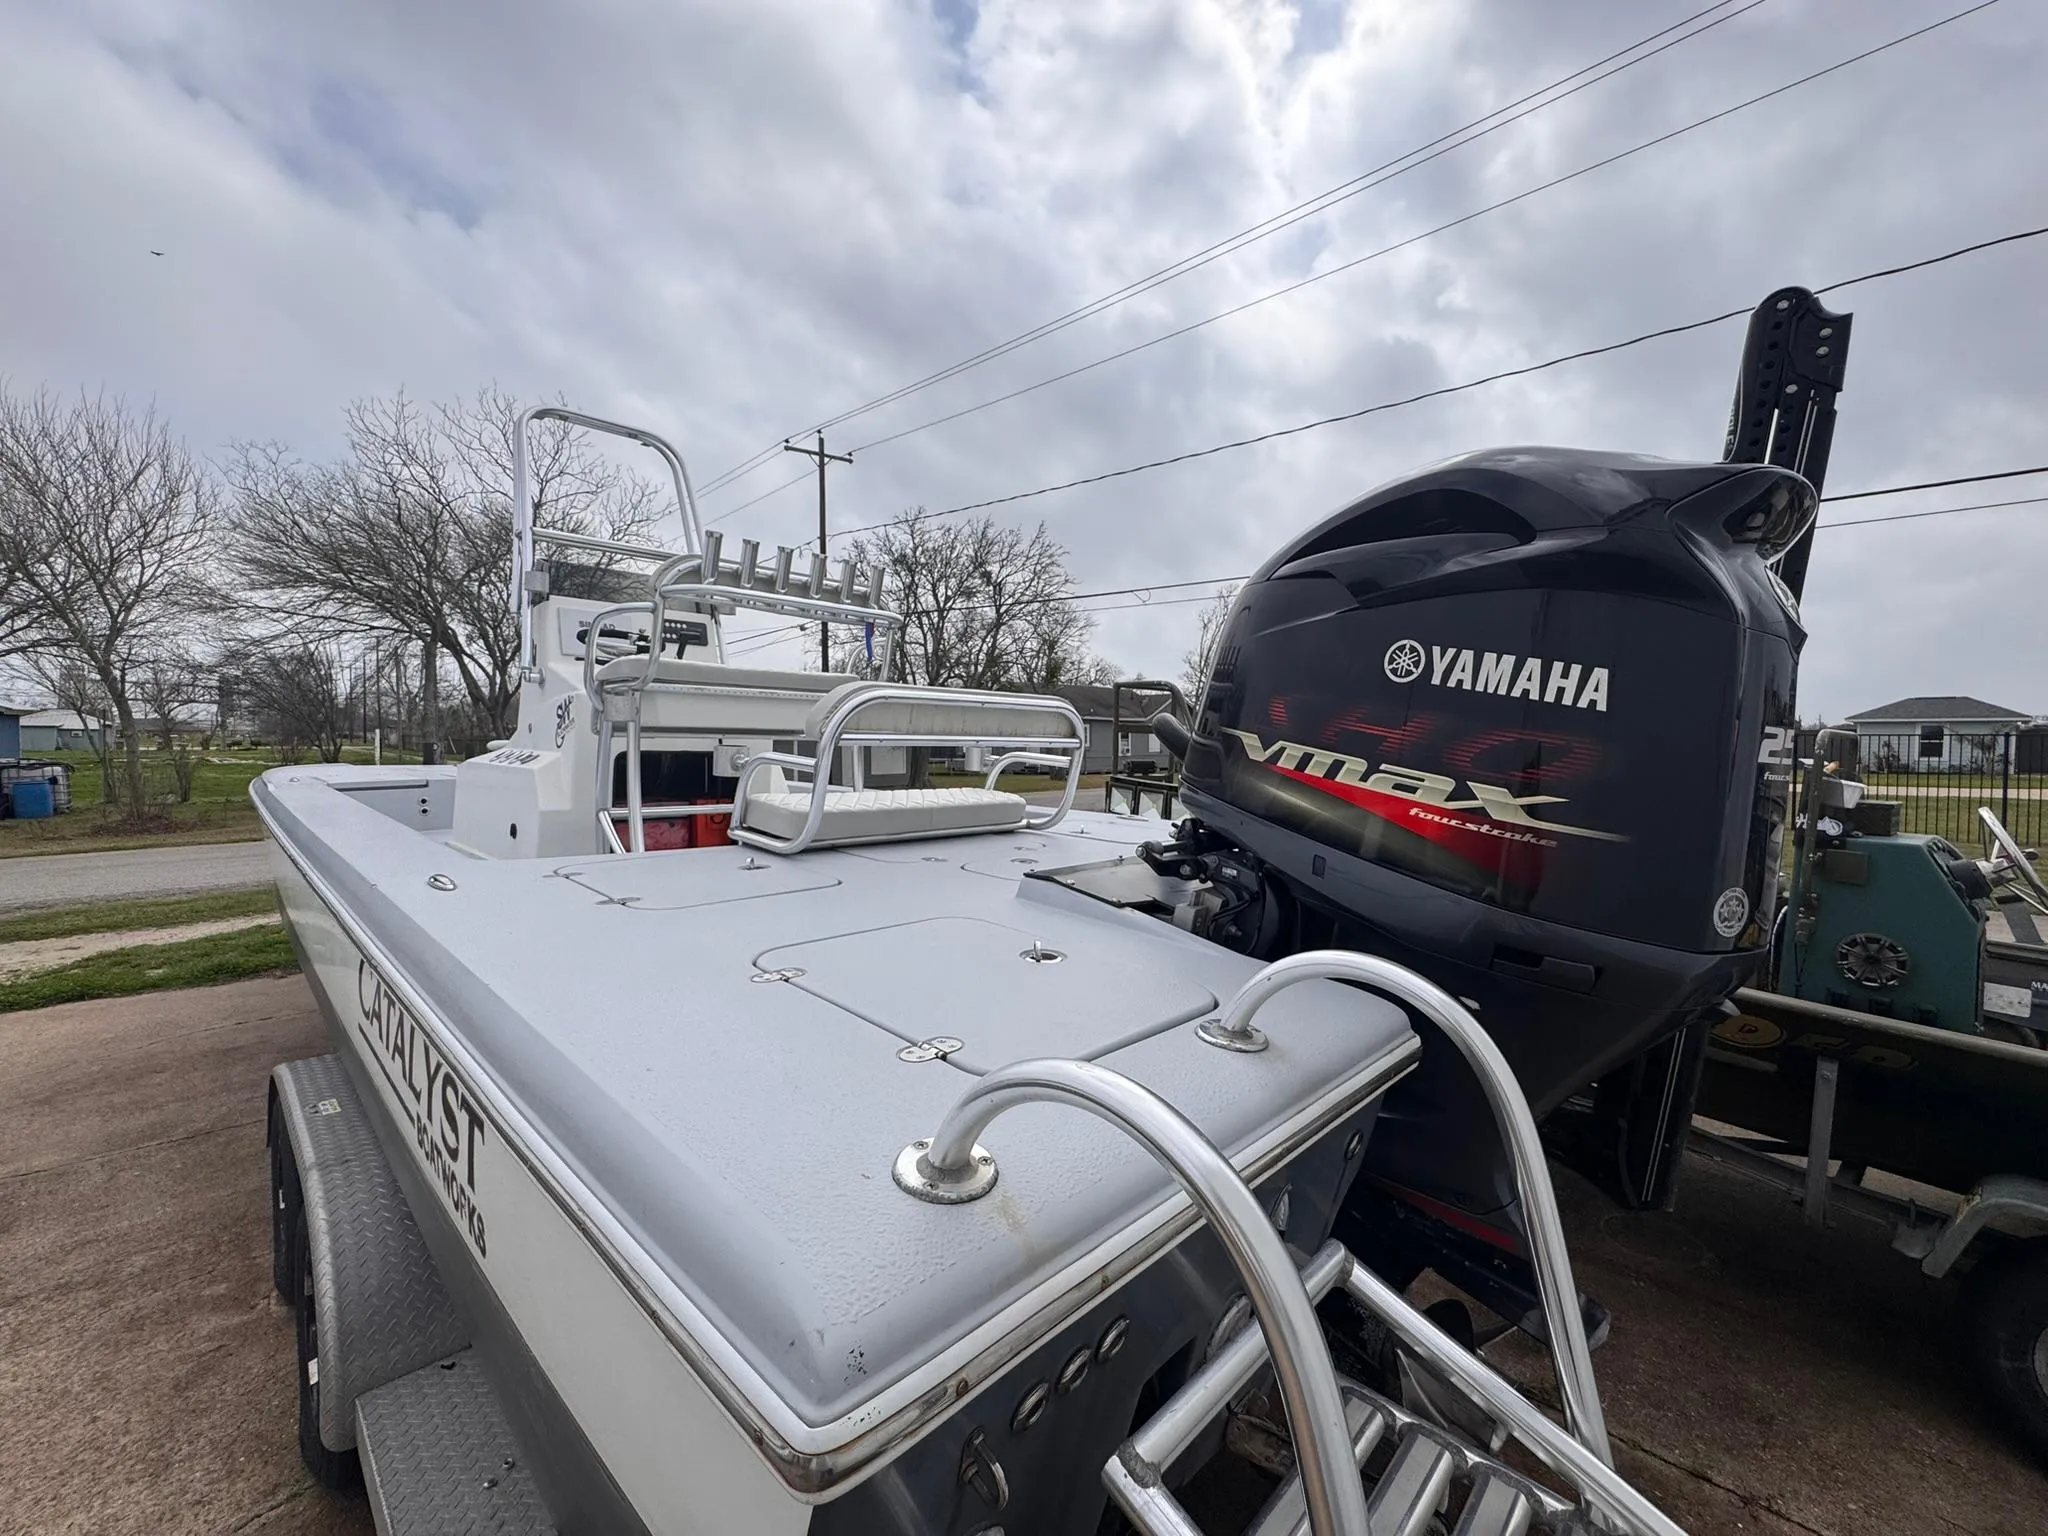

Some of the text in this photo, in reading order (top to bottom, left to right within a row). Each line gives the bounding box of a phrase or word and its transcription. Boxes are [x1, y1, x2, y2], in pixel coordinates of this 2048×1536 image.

[1431, 645, 1609, 712] YAMAHA
[1408, 807, 1558, 848] fourstroke
[358, 958, 485, 1195] CATALYST
[416, 1111, 487, 1259] BOATWORKS
